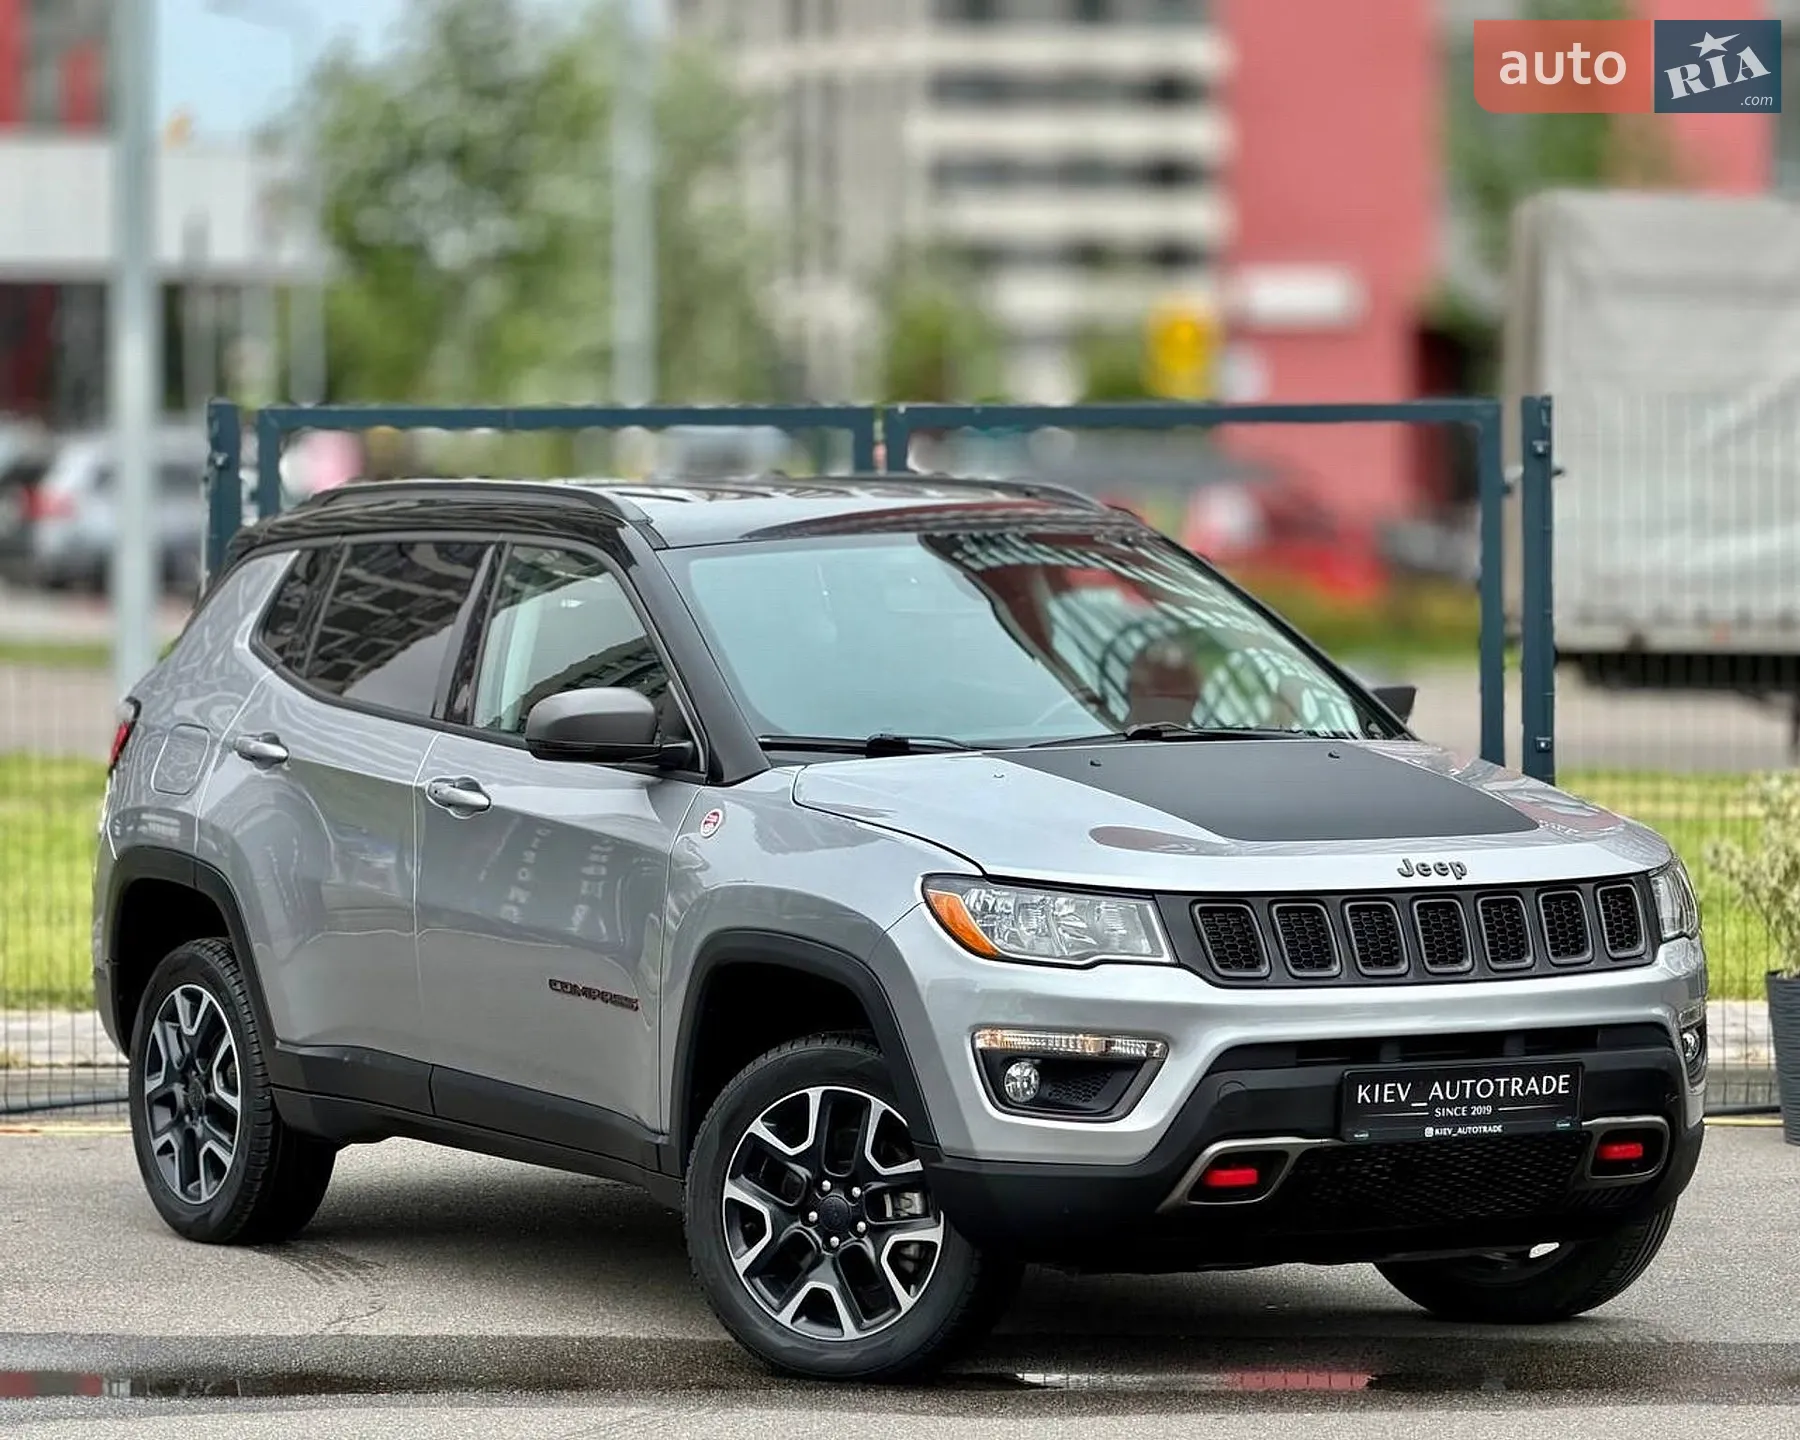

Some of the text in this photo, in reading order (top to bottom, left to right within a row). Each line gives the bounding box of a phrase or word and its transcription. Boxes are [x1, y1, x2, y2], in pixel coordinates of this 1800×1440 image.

[1397, 858, 1467, 880] Jeep
[1357, 1074, 1571, 1106] KIEV_AUTOTRADE
[1434, 1105, 1492, 1118] SINCE 2019
